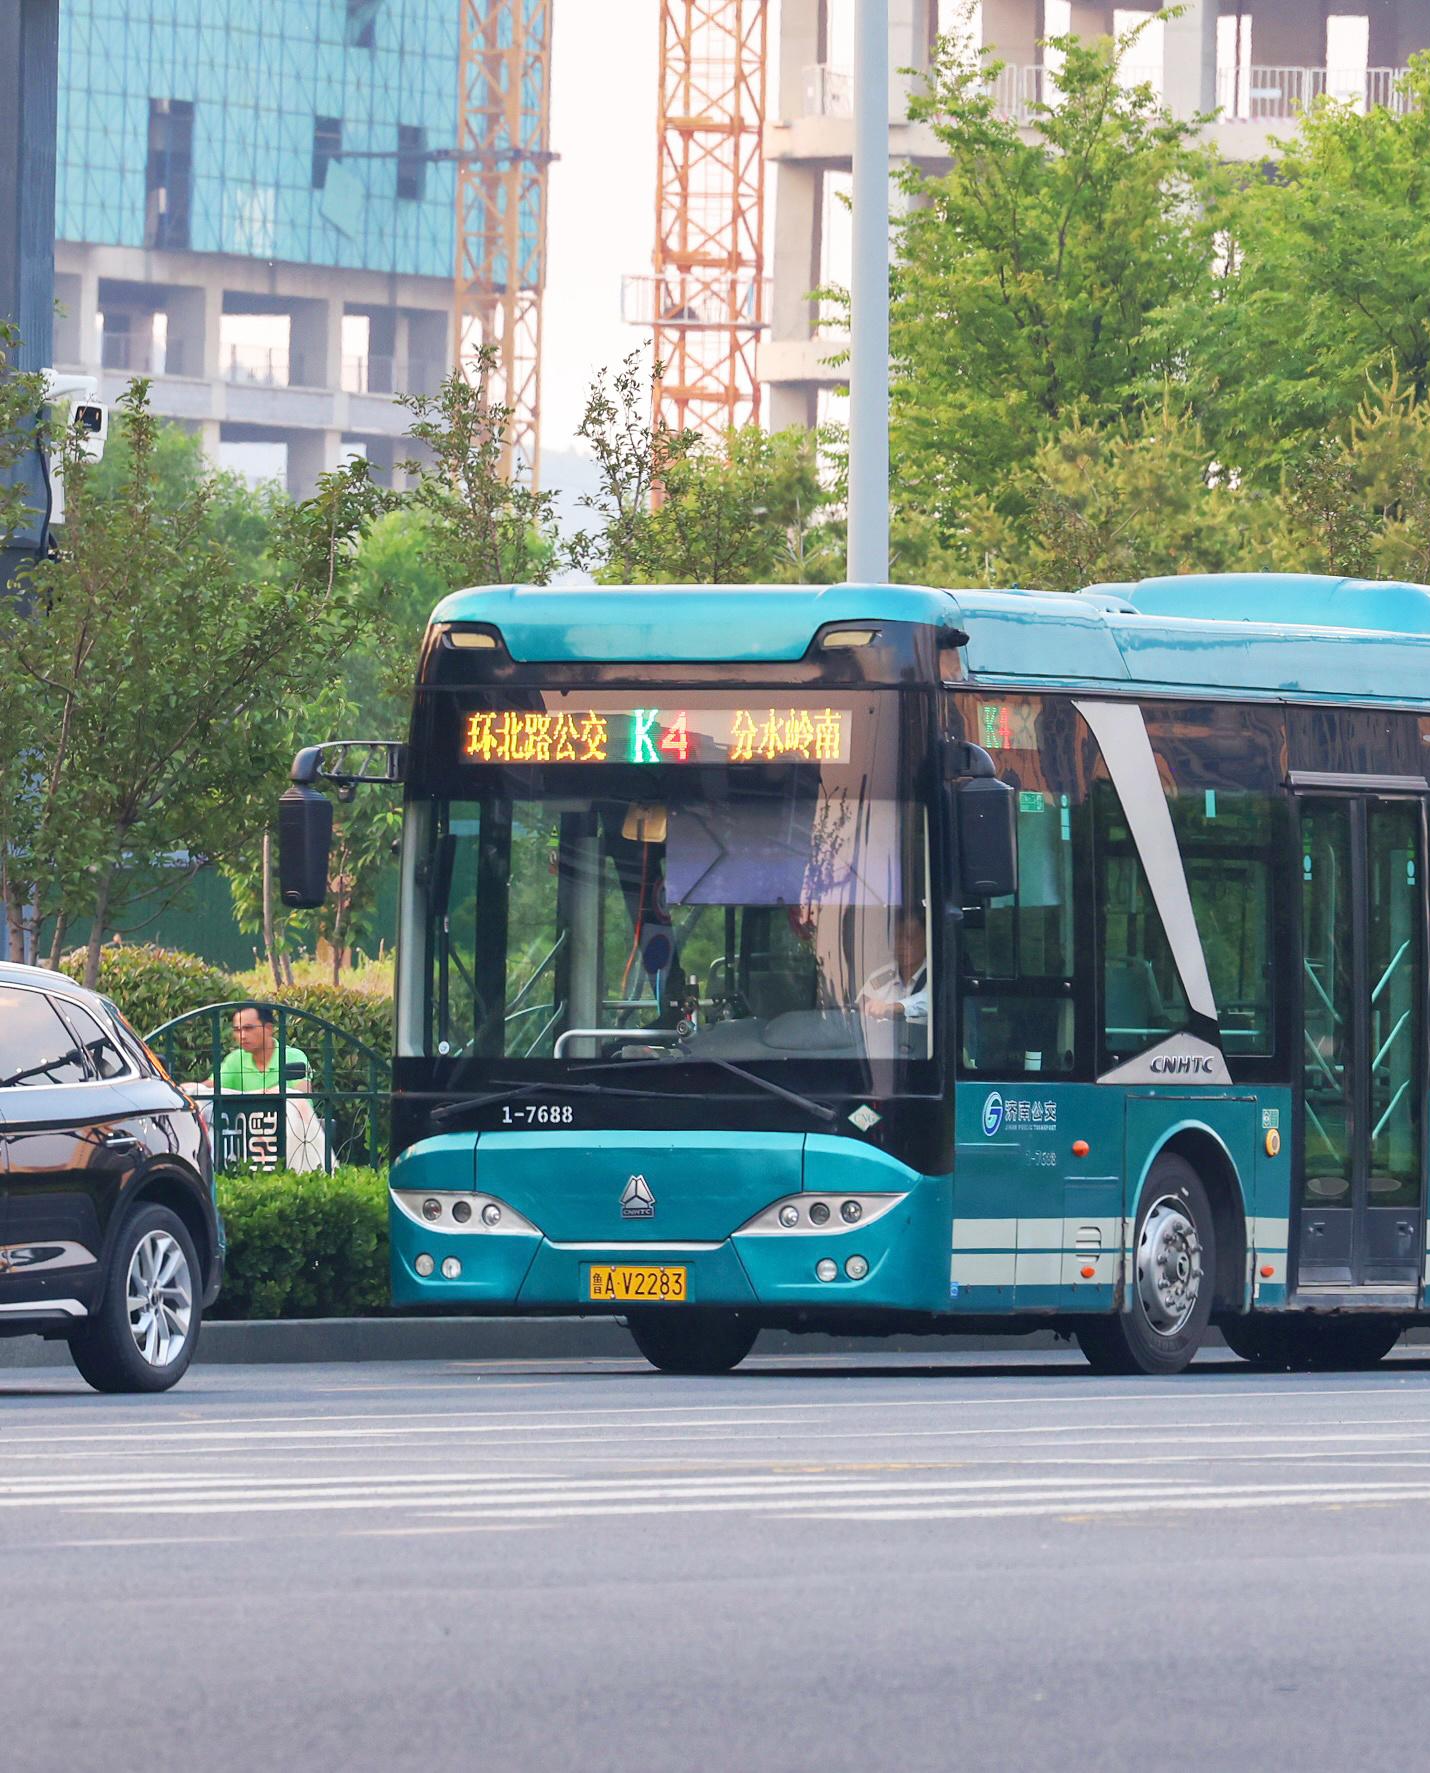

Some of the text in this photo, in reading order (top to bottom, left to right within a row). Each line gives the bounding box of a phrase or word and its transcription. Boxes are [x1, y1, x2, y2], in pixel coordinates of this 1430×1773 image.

[467, 707, 841, 763] 环北路公交 K4 分水岭南
[983, 705, 1011, 749] K4
[1150, 1055, 1214, 1074] CNHTC
[502, 1105, 573, 1124] 1-7688
[1004, 1099, 1057, 1122] 济南公交
[593, 1272, 682, 1295] 鲁A·V2283
